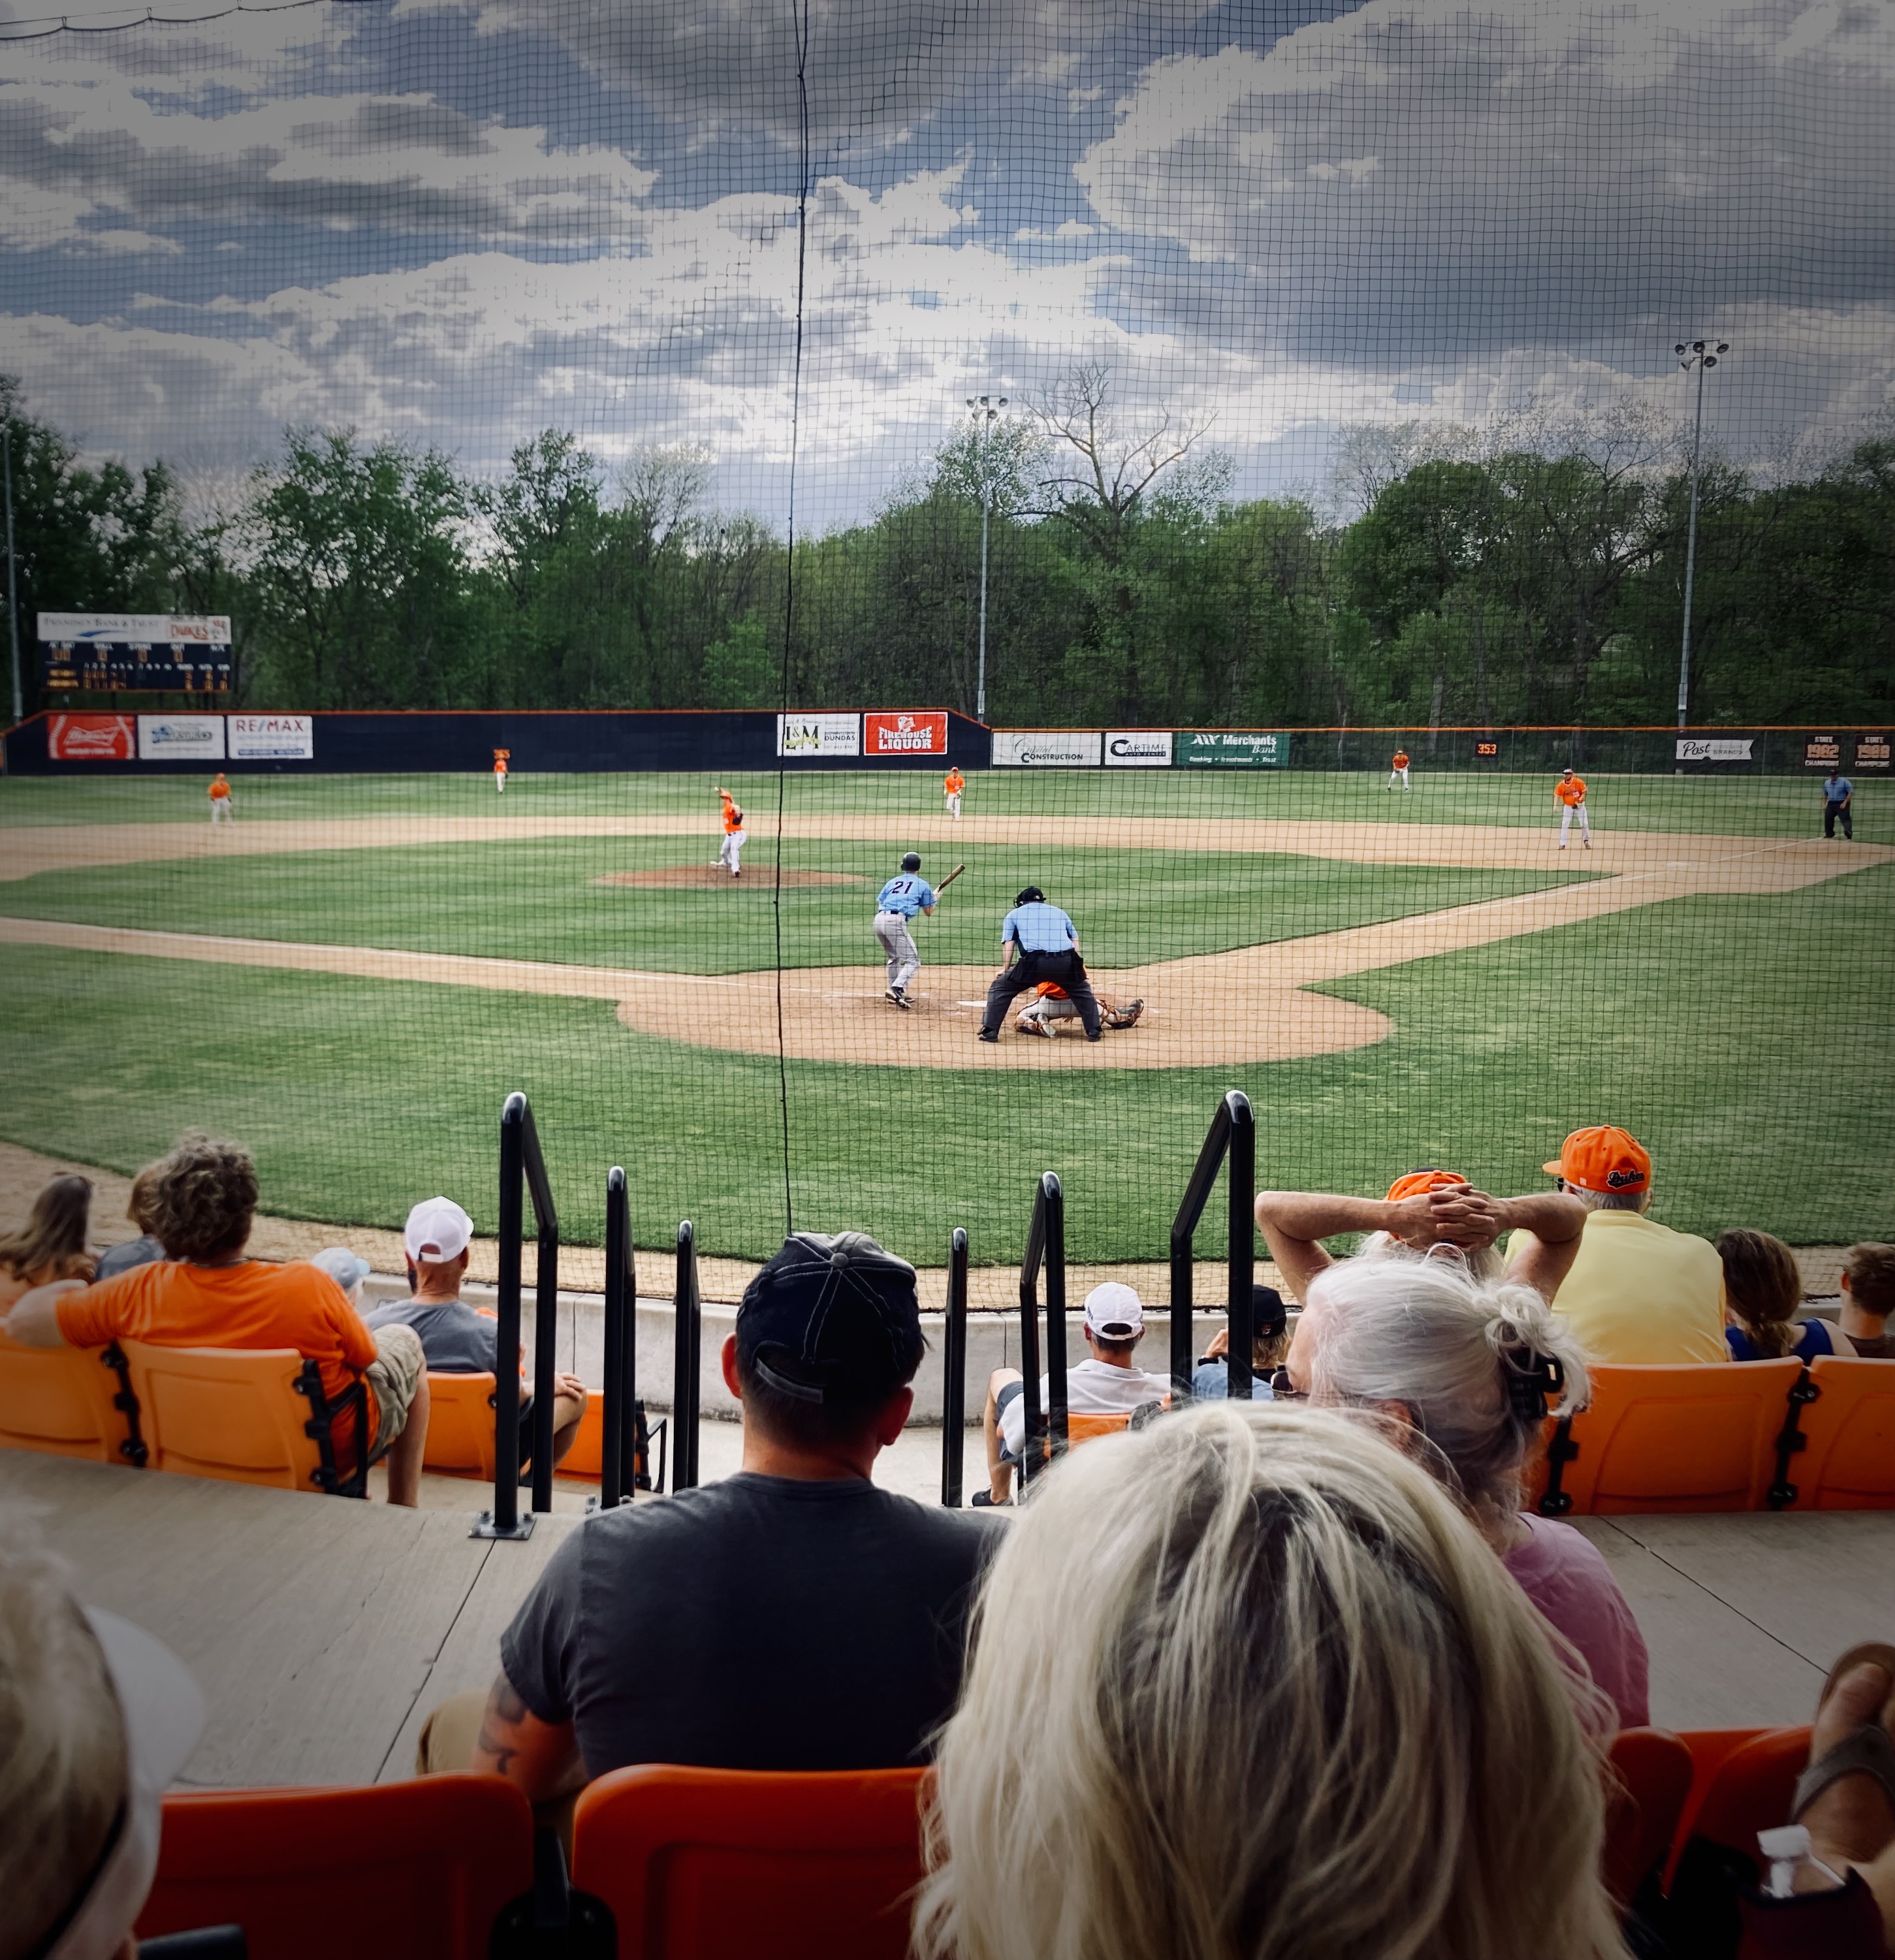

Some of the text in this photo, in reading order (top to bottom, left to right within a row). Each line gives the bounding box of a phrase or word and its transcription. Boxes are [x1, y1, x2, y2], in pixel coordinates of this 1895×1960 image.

[236, 719, 303, 731] RE/MAX
[878, 726, 932, 739] FIREHOUSE
[878, 738, 932, 750] LIQUOR
[1222, 735, 1277, 745] Merchants
[1110, 739, 1166, 757] CARTIME
[1252, 744, 1277, 753] Bank
[1478, 744, 1497, 754] 353
[1683, 741, 1711, 757] Post
[1807, 744, 1839, 758] 1982
[1021, 752, 1083, 763] CONSTRUCTION
[891, 881, 914, 894] 21
